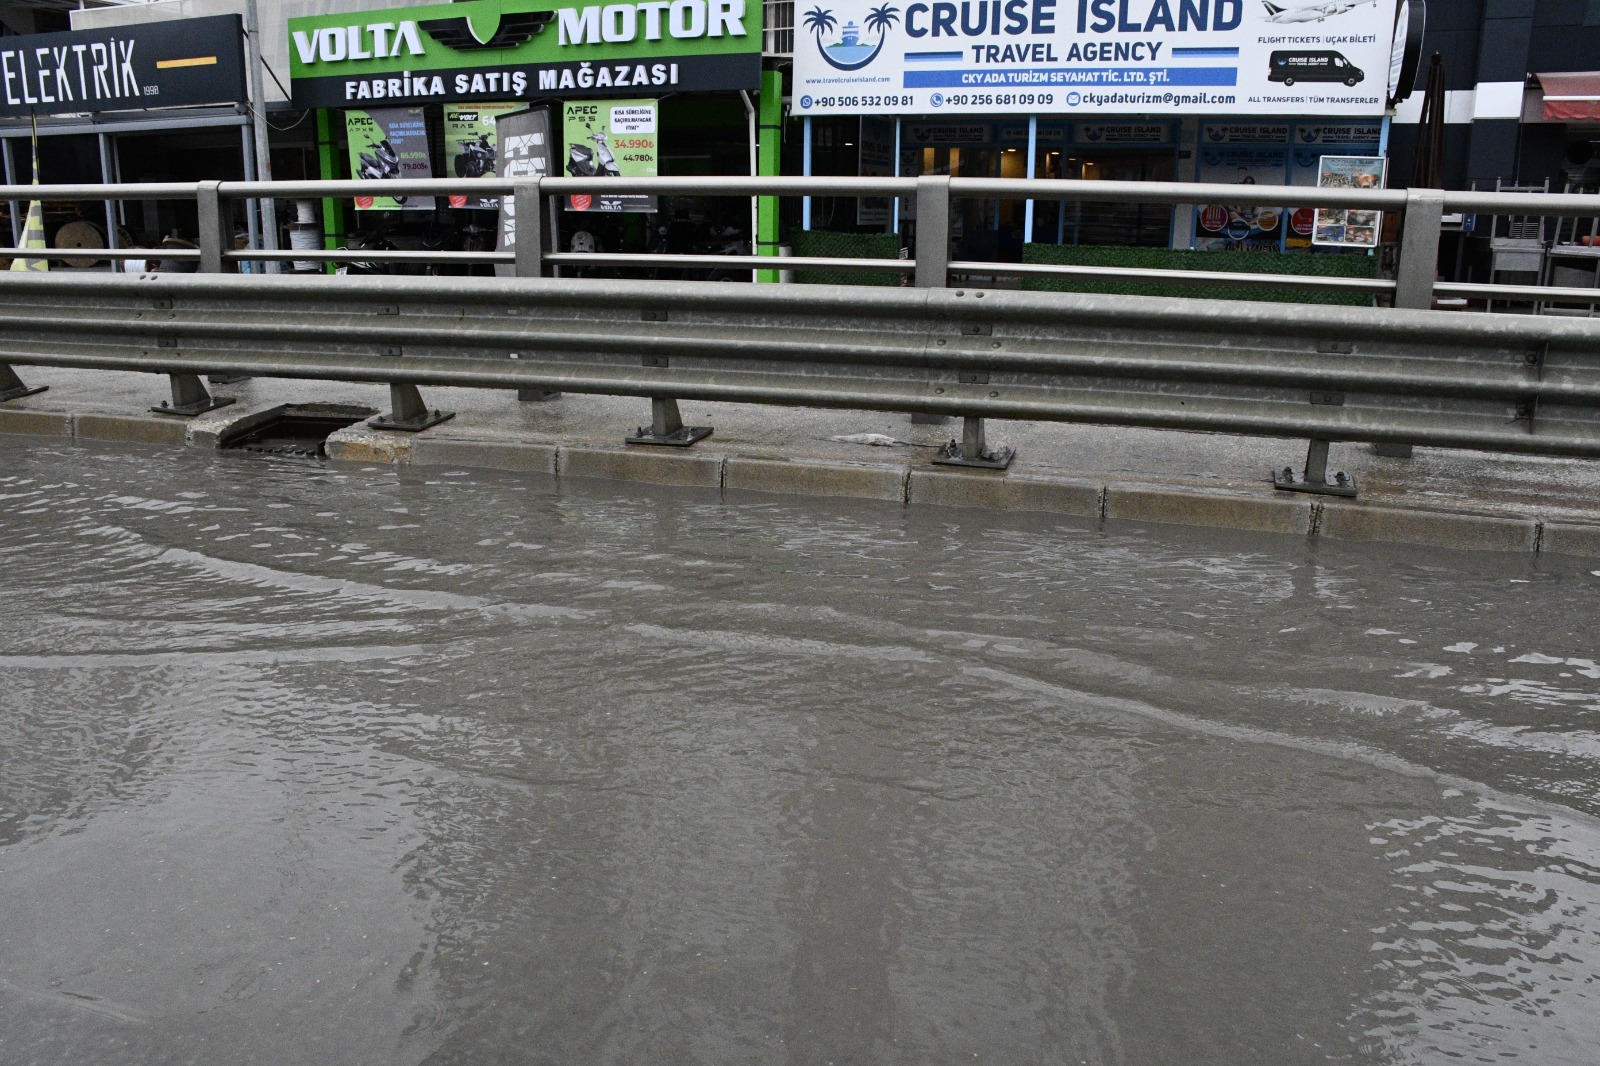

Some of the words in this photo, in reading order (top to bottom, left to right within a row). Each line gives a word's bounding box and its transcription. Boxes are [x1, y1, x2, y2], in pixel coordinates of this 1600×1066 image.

[904, 0, 1056, 38] CRUISE
[1076, 0, 1243, 34] ISLAND
[292, 20, 426, 64] VOLTA
[557, 0, 748, 46] MOTOR
[1326, 36, 1348, 45] UÇAK
[1350, 34, 1376, 43] BİLETİ
[971, 44, 1058, 63] TRAVEL
[1066, 42, 1164, 62] AGENCY
[1, 36, 140, 105] ELEKTRİK
[962, 74, 982, 84] CKY
[984, 73, 1006, 84] ADA
[1008, 70, 1048, 83] TURİZM
[1050, 72, 1103, 82] SEYAHAT
[1102, 69, 1122, 82] TİC.
[1124, 72, 1147, 82] LTD.
[1149, 69, 1170, 84] ŞTİ.
[345, 70, 446, 100] FABRİKA
[454, 72, 528, 96] SATIŞ
[538, 62, 679, 90] MAĞAZASI
[806, 76, 890, 84] www.travelcruiseisland.com
[143, 85, 160, 96] 1998
[814, 96, 835, 106] +90
[838, 96, 858, 106] 506
[862, 96, 881, 106] 532
[884, 96, 899, 106] 09
[901, 96, 914, 106] 81
[946, 95, 968, 105] +90
[970, 95, 992, 105] 256
[996, 94, 1016, 104] 681
[1019, 94, 1034, 104] 09
[1037, 94, 1053, 104] 09
[1082, 92, 1236, 106] ckyadaturizm@gmail.com
[567, 106, 598, 115] APEC
[614, 139, 654, 148] 34.990₺
